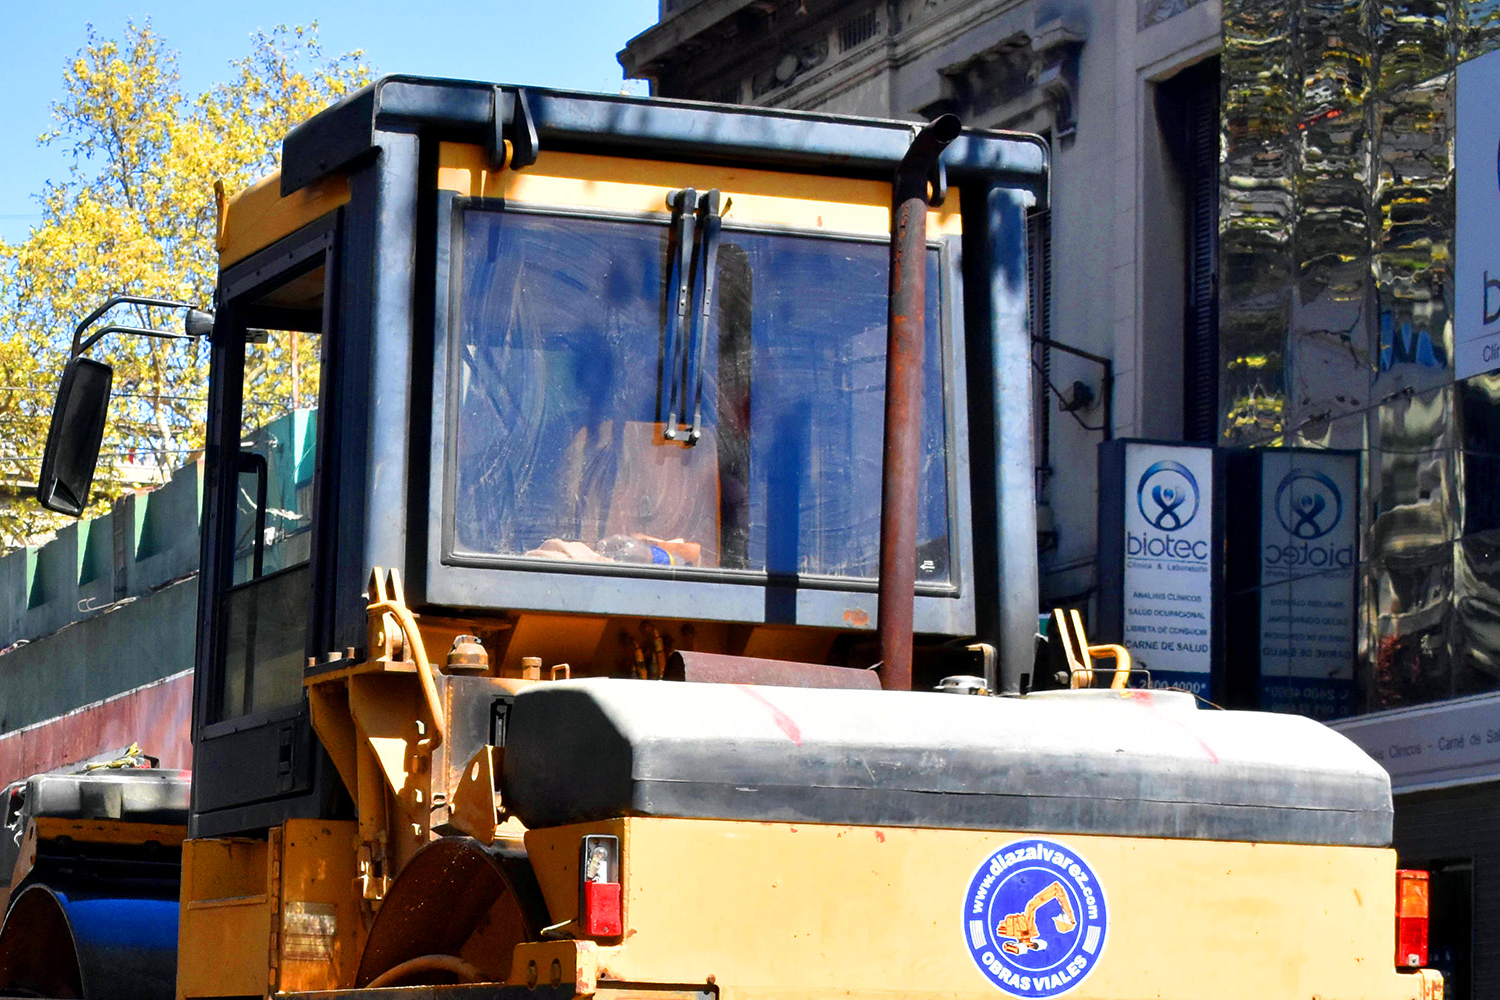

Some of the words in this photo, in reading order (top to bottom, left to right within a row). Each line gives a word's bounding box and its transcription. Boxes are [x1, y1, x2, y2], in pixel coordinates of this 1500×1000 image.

[1127, 531, 1208, 560] biotec
[1128, 608, 1153, 616] SALUD
[1154, 609, 1206, 619] OCUPACIONAL
[1126, 625, 1156, 633] LIBRETA
[1158, 626, 1168, 634] DE
[1169, 627, 1208, 636] CONDUCIR
[1161, 641, 1174, 651] DE
[1177, 642, 1209, 653] SALUD
[1469, 734, 1481, 746] de
[972, 843, 1099, 920] www.diazalvarez.com
[981, 951, 1031, 991] OBRAS
[1033, 954, 1088, 992] VIALES
